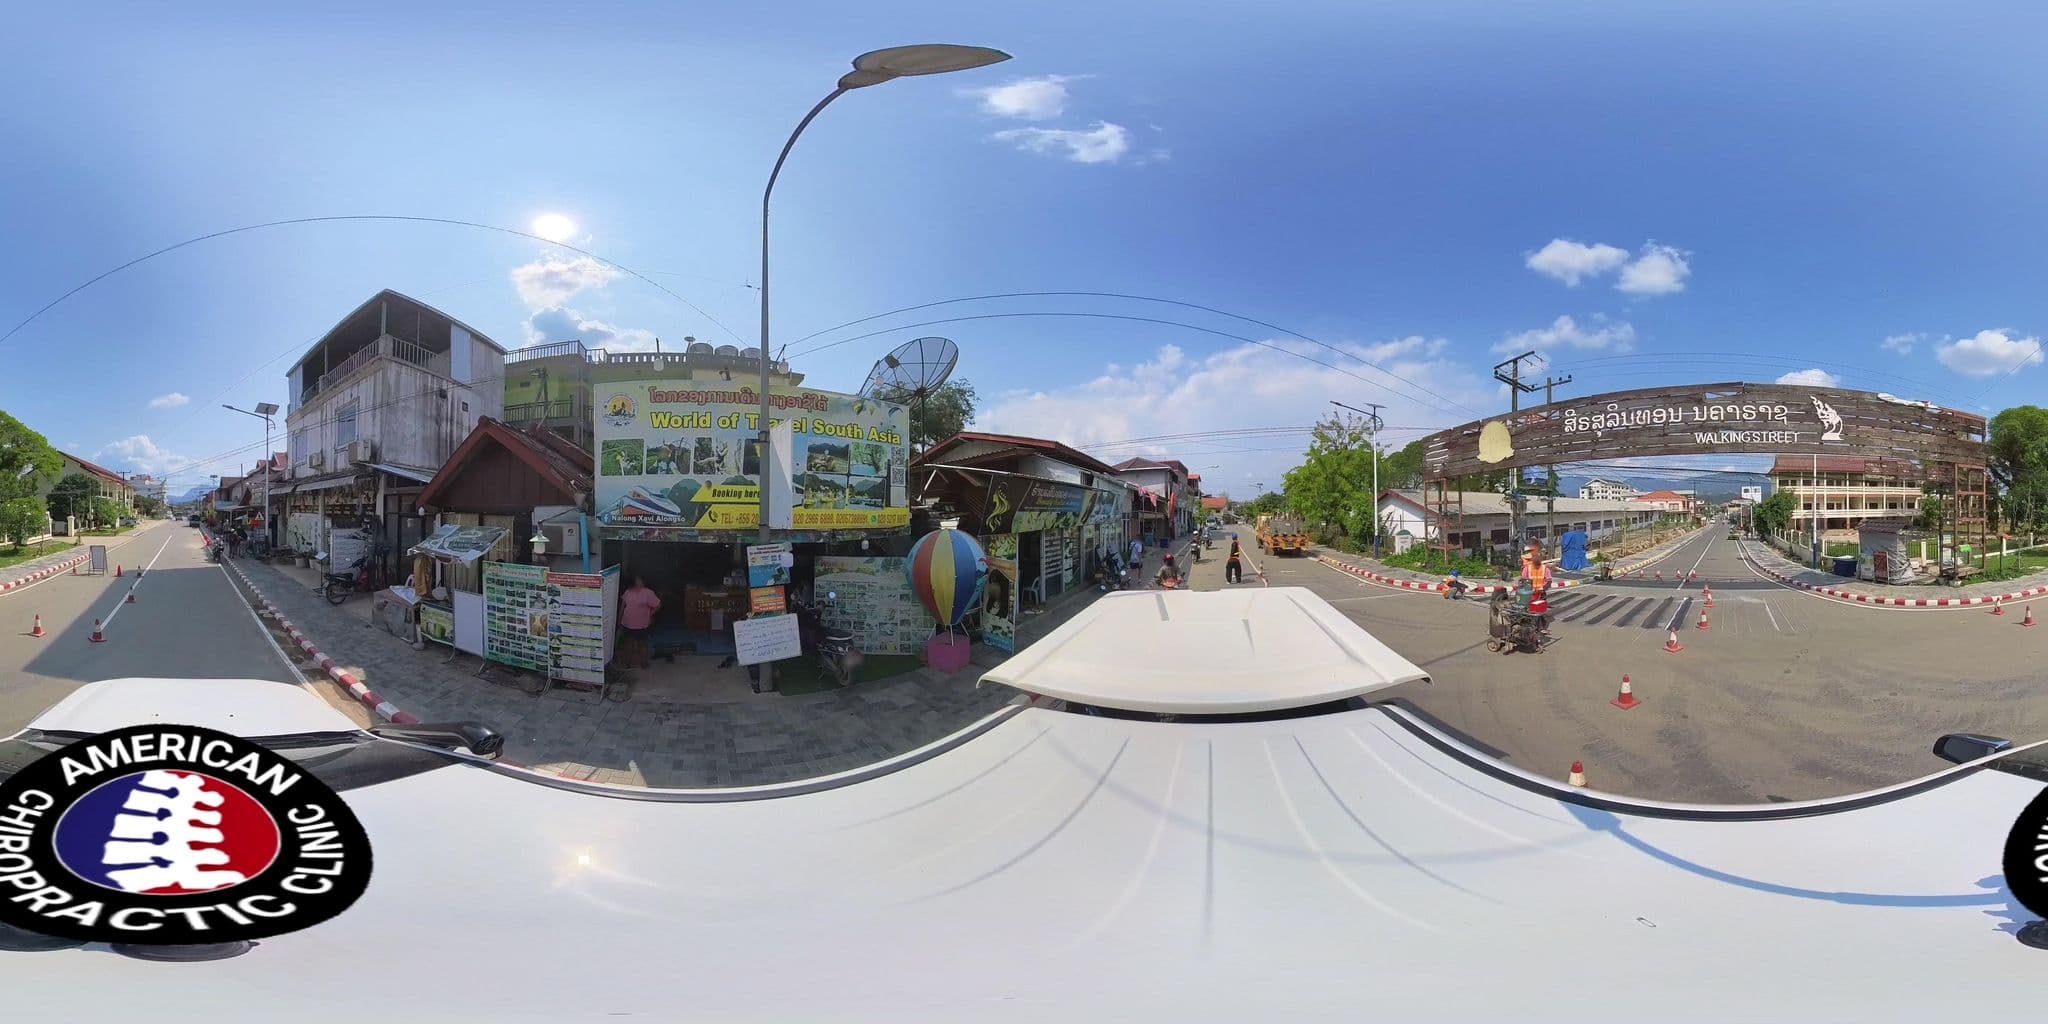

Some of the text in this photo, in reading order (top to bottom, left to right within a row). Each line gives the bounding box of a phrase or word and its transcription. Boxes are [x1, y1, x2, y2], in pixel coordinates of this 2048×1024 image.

[651, 412, 901, 444] World of Tael South Asia
[712, 489, 743, 499] Booking
